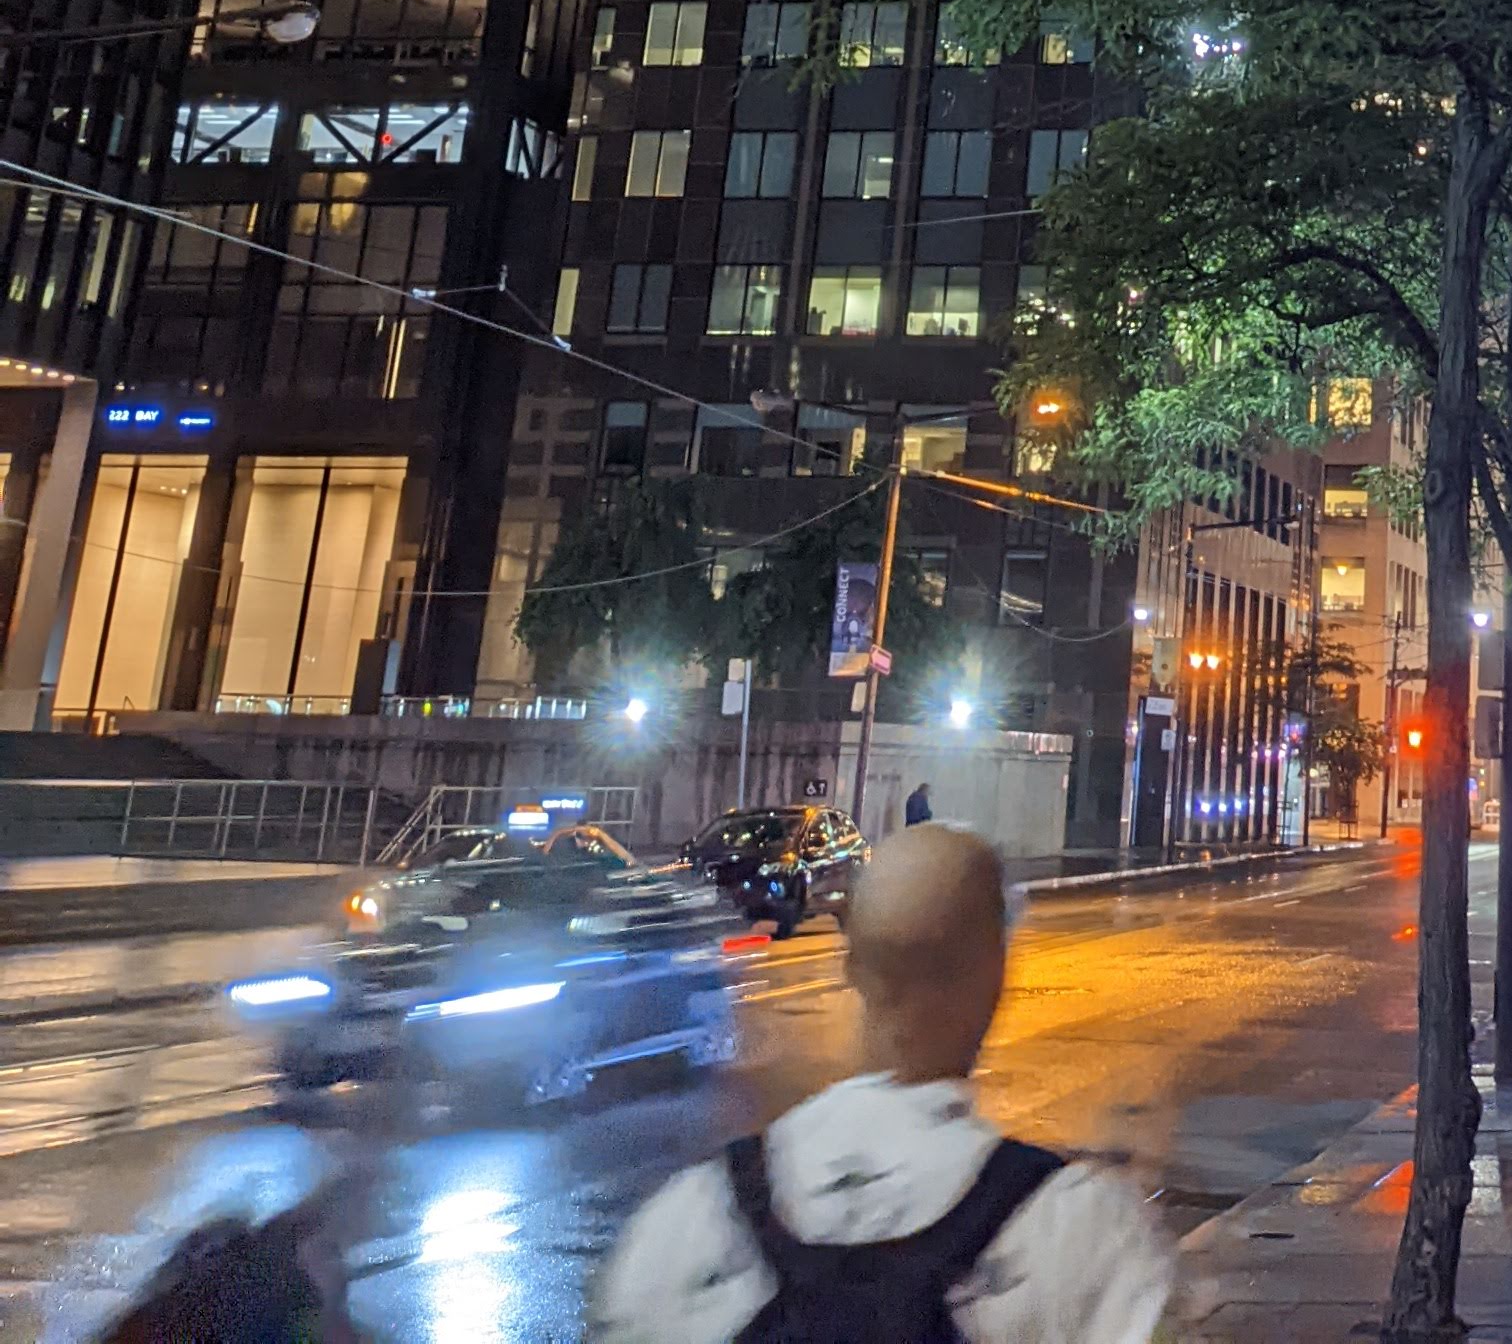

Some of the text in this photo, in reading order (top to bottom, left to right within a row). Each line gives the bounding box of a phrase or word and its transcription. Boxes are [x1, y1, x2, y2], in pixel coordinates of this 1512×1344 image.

[108, 409, 160, 421] 222 BAY
[835, 567, 850, 623] CONNECT
